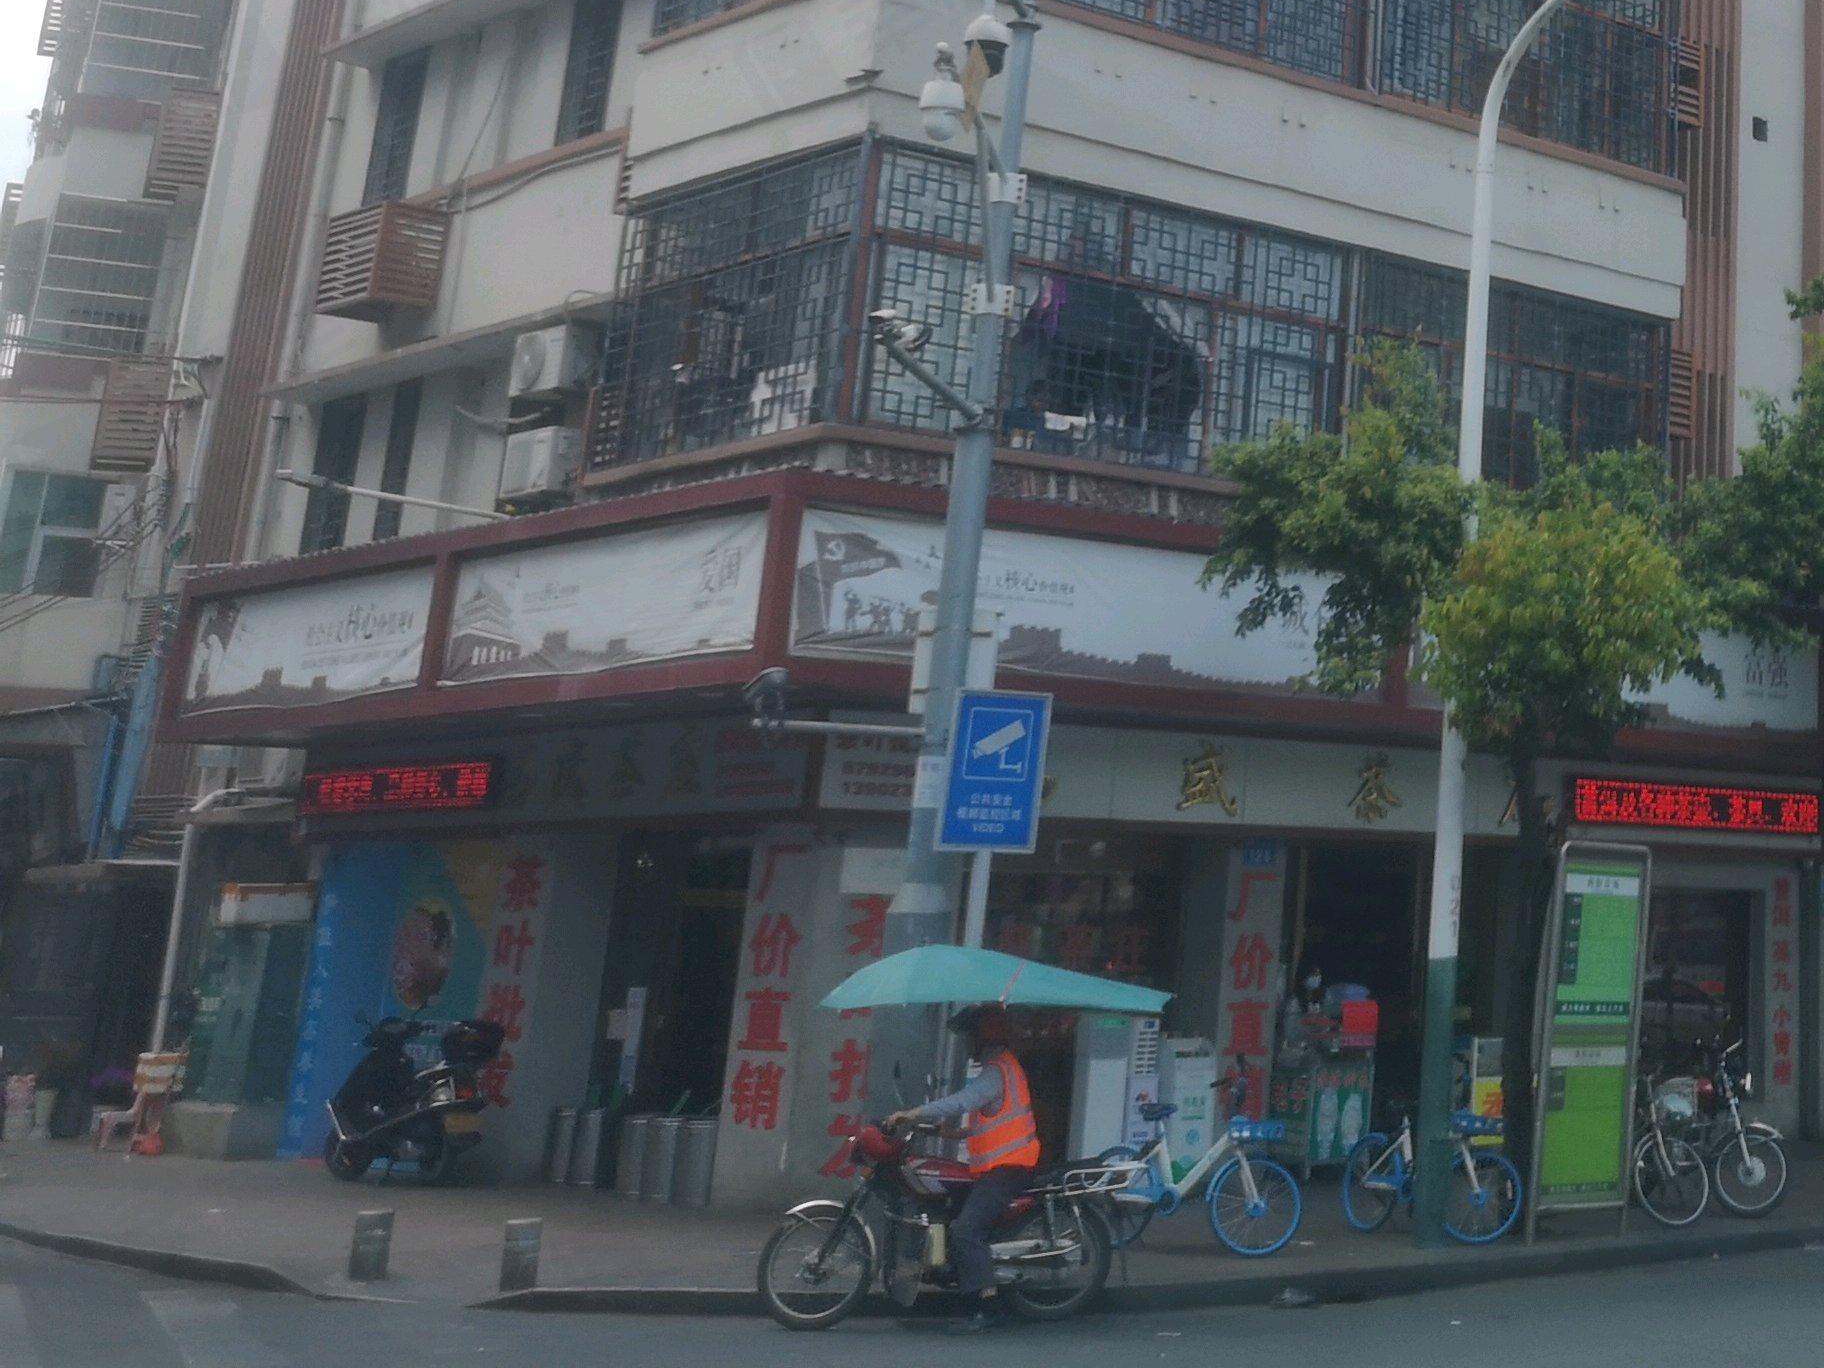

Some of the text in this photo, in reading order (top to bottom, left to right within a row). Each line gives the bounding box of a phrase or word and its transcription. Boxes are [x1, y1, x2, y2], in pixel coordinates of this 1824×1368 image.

[730, 843, 812, 1130] 厂价直销
[1220, 872, 1281, 1122] 厂价直销
